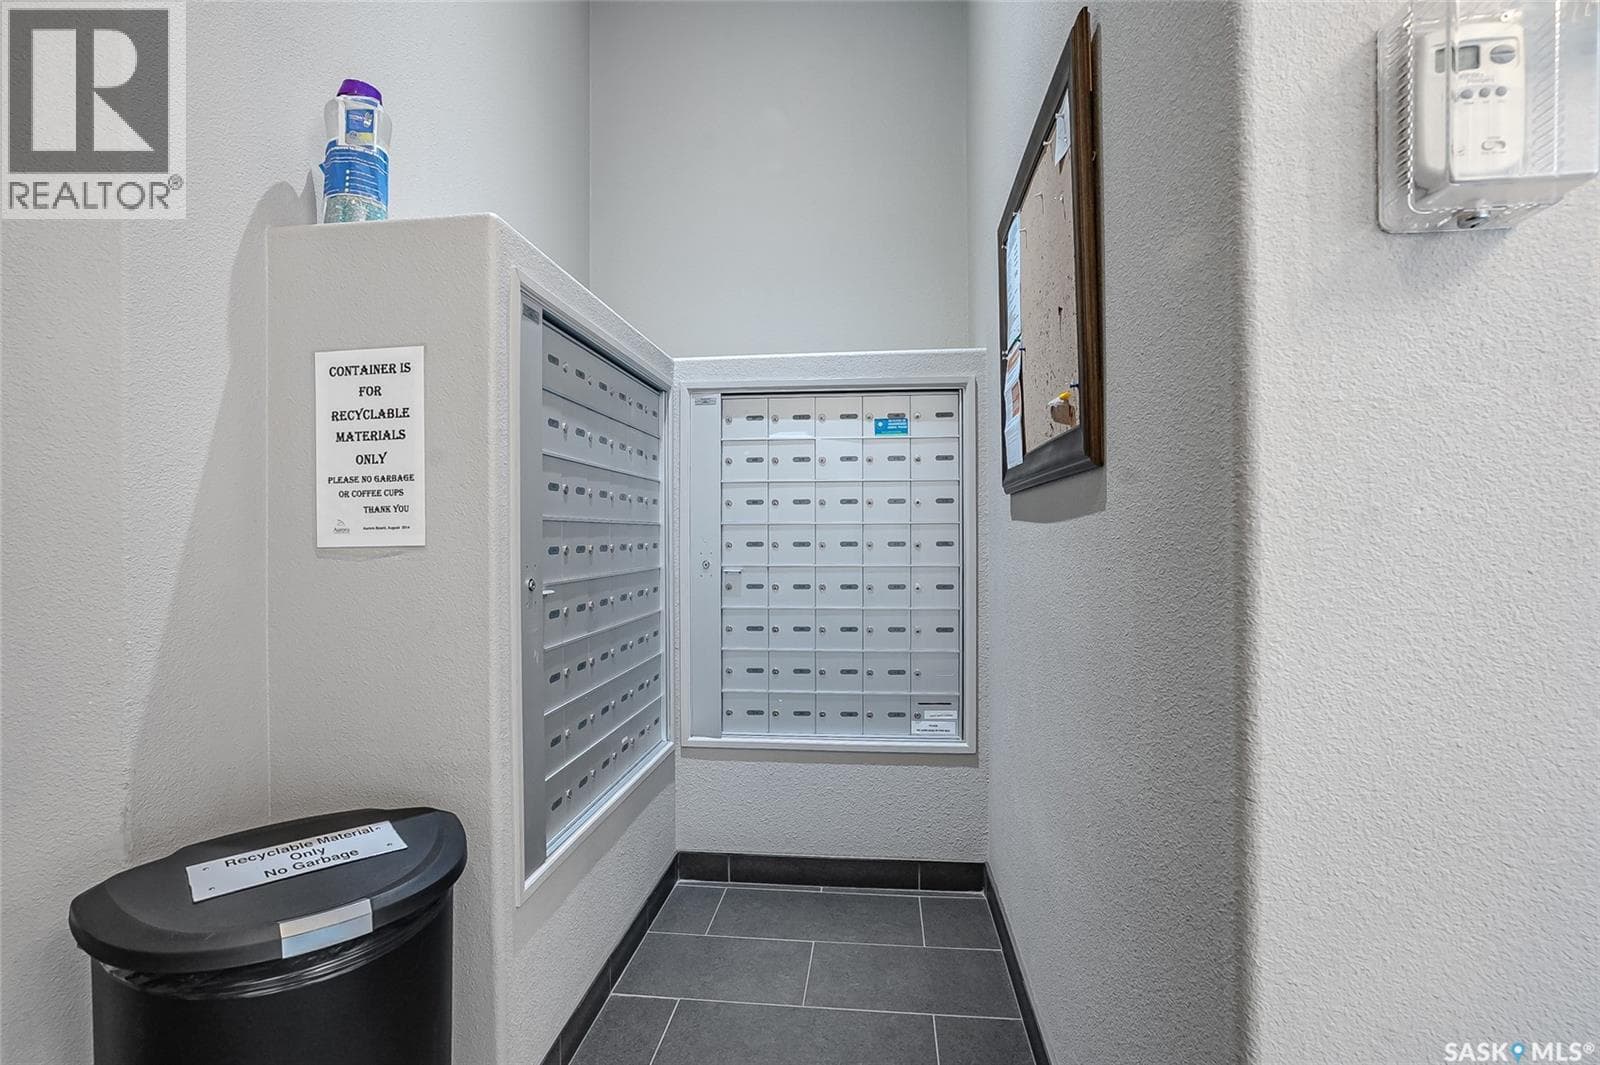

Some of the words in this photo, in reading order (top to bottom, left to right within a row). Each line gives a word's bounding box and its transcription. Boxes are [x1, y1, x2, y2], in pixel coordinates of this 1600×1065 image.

[328, 362, 397, 377] CONTAINER
[400, 362, 411, 373] IS
[358, 385, 382, 397] FOR
[331, 407, 410, 422] RECYCLABLE
[335, 429, 406, 443] MATERIALS
[355, 451, 388, 465] ONLY
[328, 476, 360, 484] PLEASE
[361, 475, 372, 483] NO
[373, 473, 415, 483] GARBAGE
[338, 490, 350, 498] OR
[351, 489, 382, 498] COFFEE
[383, 488, 404, 497] CUPS
[363, 505, 391, 514] THANK
[393, 504, 410, 513] YOU
[225, 840, 314, 867] Recyclable
[317, 825, 375, 846] Material
[289, 845, 326, 861] Only
[264, 867, 288, 879] No
[292, 847, 360, 871] Garbage
